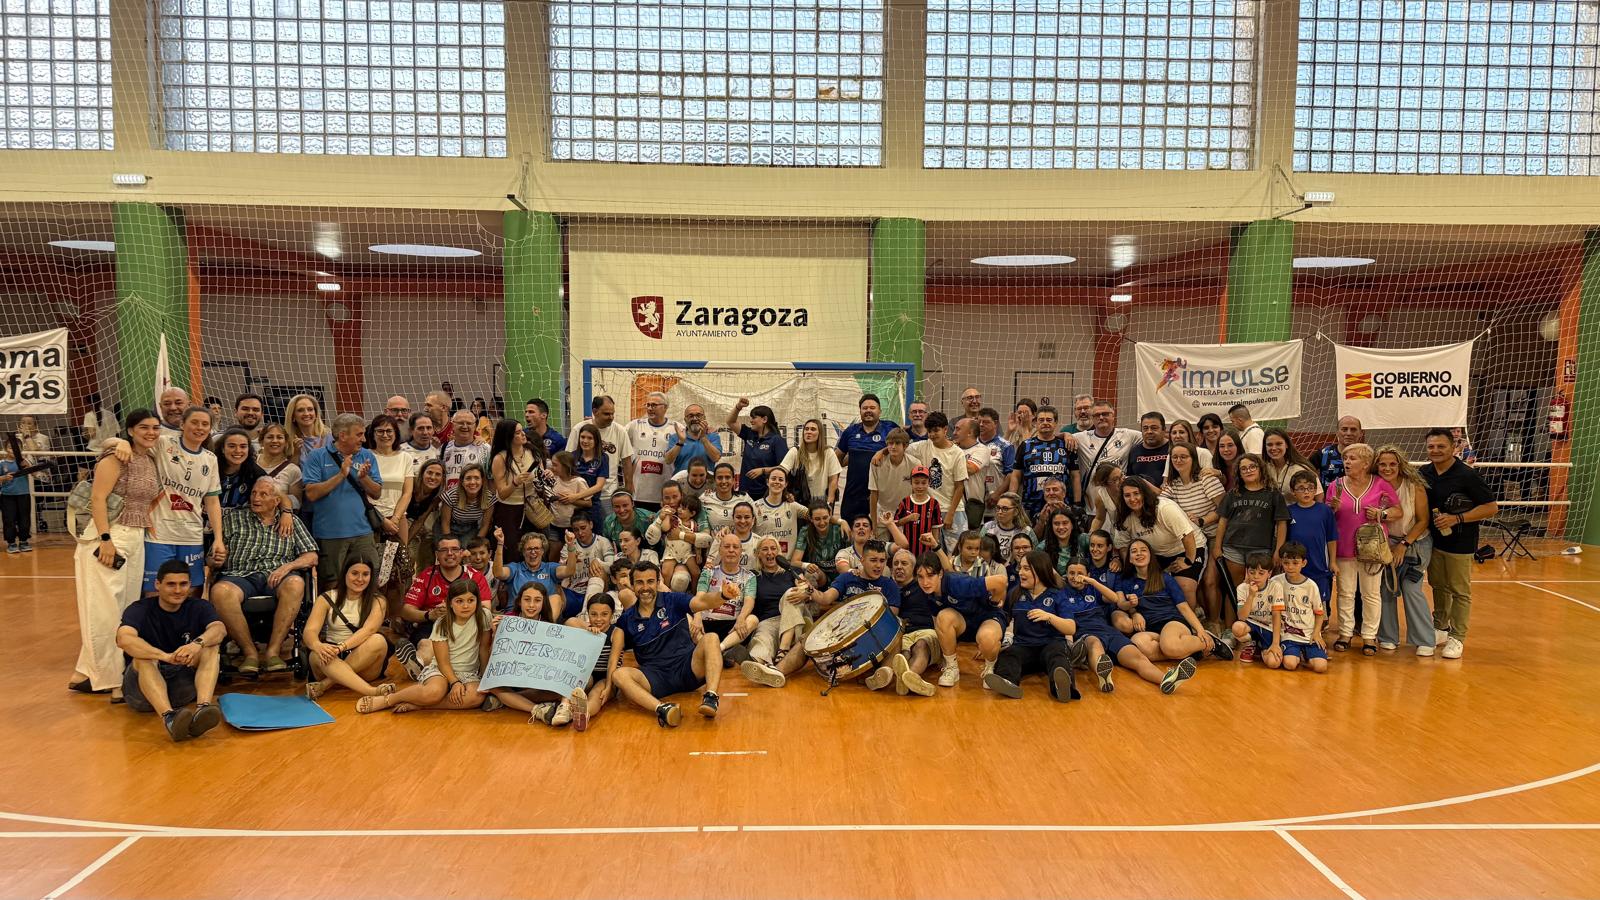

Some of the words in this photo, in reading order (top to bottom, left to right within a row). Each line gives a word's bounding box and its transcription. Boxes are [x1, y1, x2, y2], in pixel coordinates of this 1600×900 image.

[675, 301, 808, 336] Zaragoza
[675, 329, 738, 338] AYUNTAMIENTO
[1374, 371, 1451, 384] GOBIERNO
[1182, 389, 1228, 397] FISIOTERAPIA
[1374, 387, 1393, 398] DE
[1399, 385, 1461, 398] ARAGON
[454, 454, 462, 465] 10
[1042, 451, 1053, 462] 99
[1233, 499, 1269, 508] BROWNIE
[723, 509, 729, 518] 9
[774, 518, 782, 528] 10
[999, 537, 1010, 548] 22
[1287, 594, 1295, 603] 17
